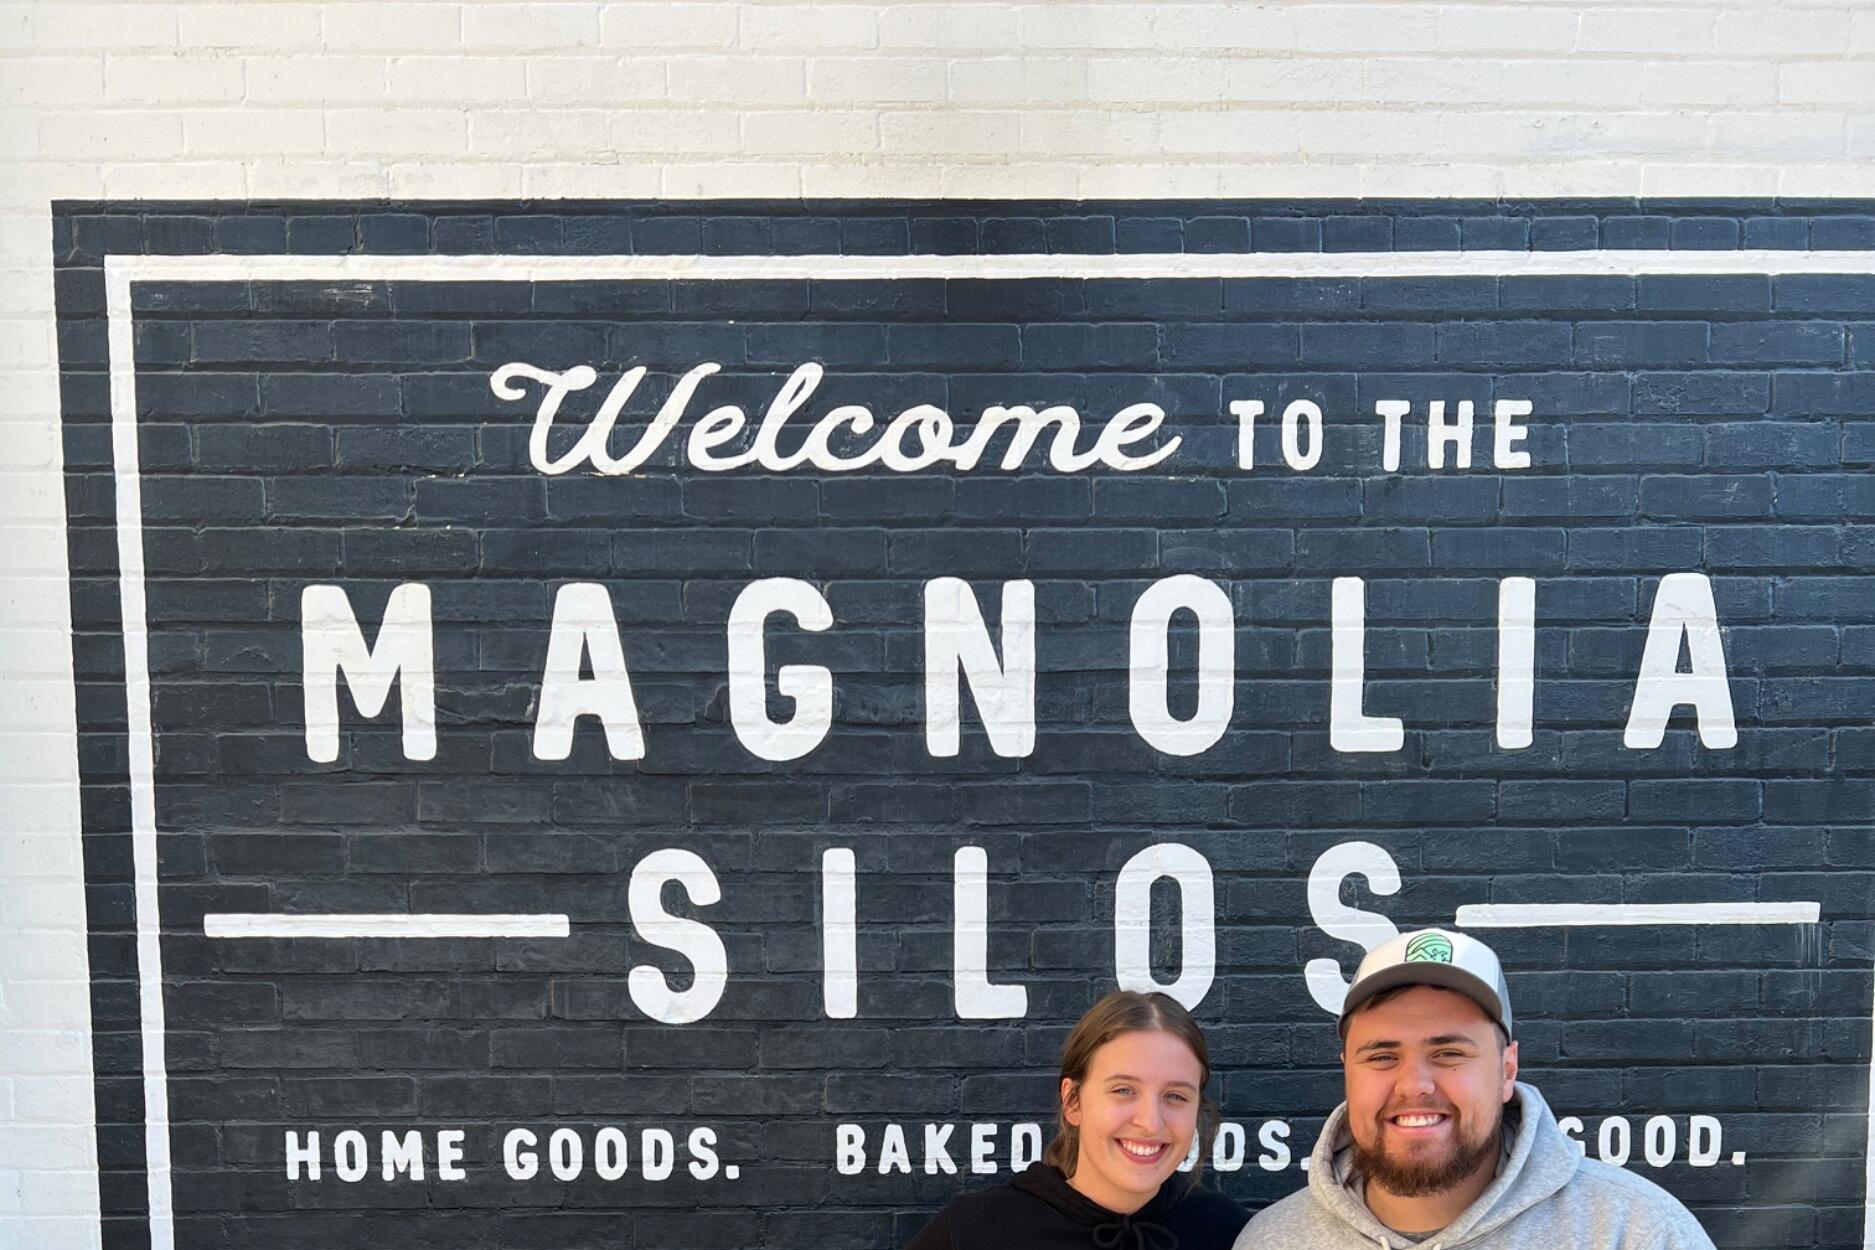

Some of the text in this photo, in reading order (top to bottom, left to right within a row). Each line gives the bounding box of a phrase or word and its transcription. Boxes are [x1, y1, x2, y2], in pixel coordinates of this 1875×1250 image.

[489, 361, 1534, 477] Welcome TO THE
[300, 572, 1738, 764] MAGNOLIA
[627, 841, 1403, 1025] SILOS
[285, 1129, 466, 1183] HOME
[503, 1126, 740, 1182] GOODS.
[836, 1122, 1043, 1175] BAKED
